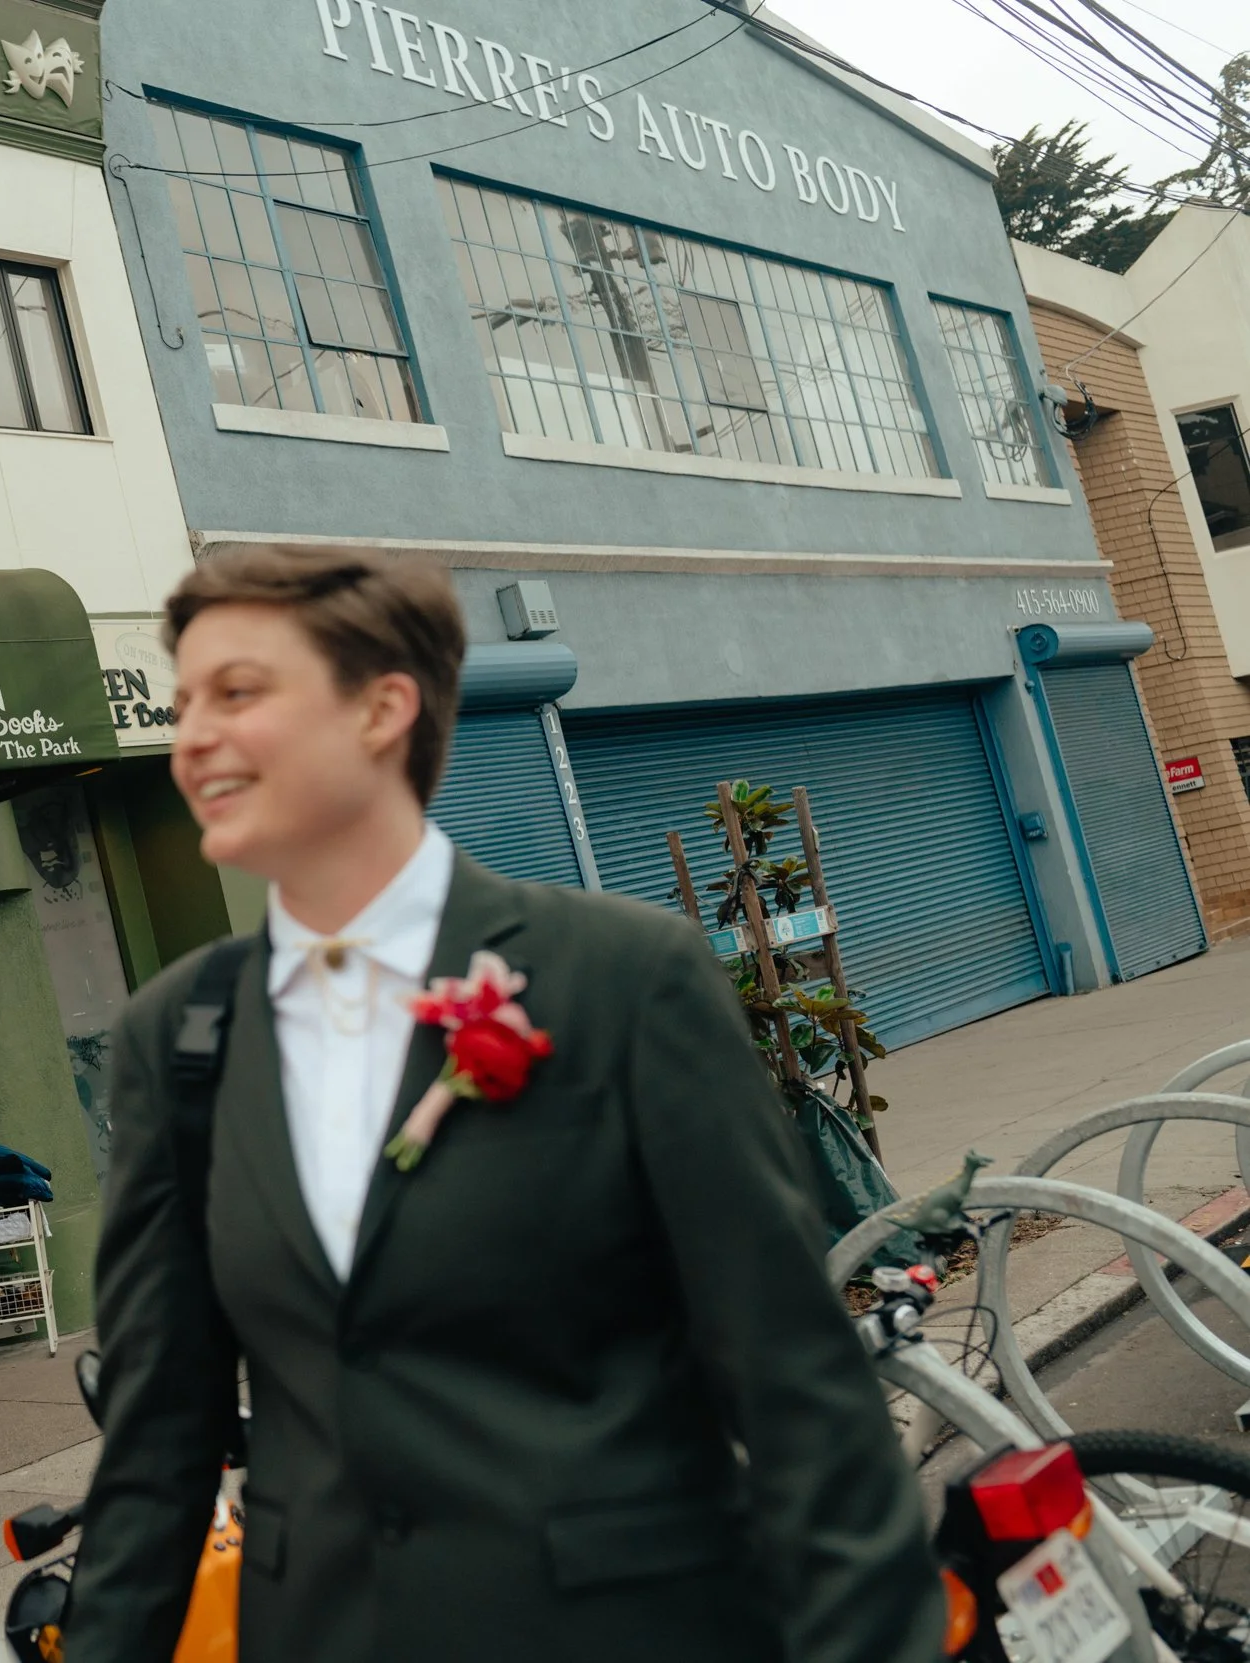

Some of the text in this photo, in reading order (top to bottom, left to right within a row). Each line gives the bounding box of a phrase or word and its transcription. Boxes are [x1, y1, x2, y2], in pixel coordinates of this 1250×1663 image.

[315, 0, 906, 232] PIERRE'S AUTO BODY
[1015, 588, 1100, 616] 415-564-0900
[0, 740, 37, 760] The
[39, 736, 82, 757] Park
